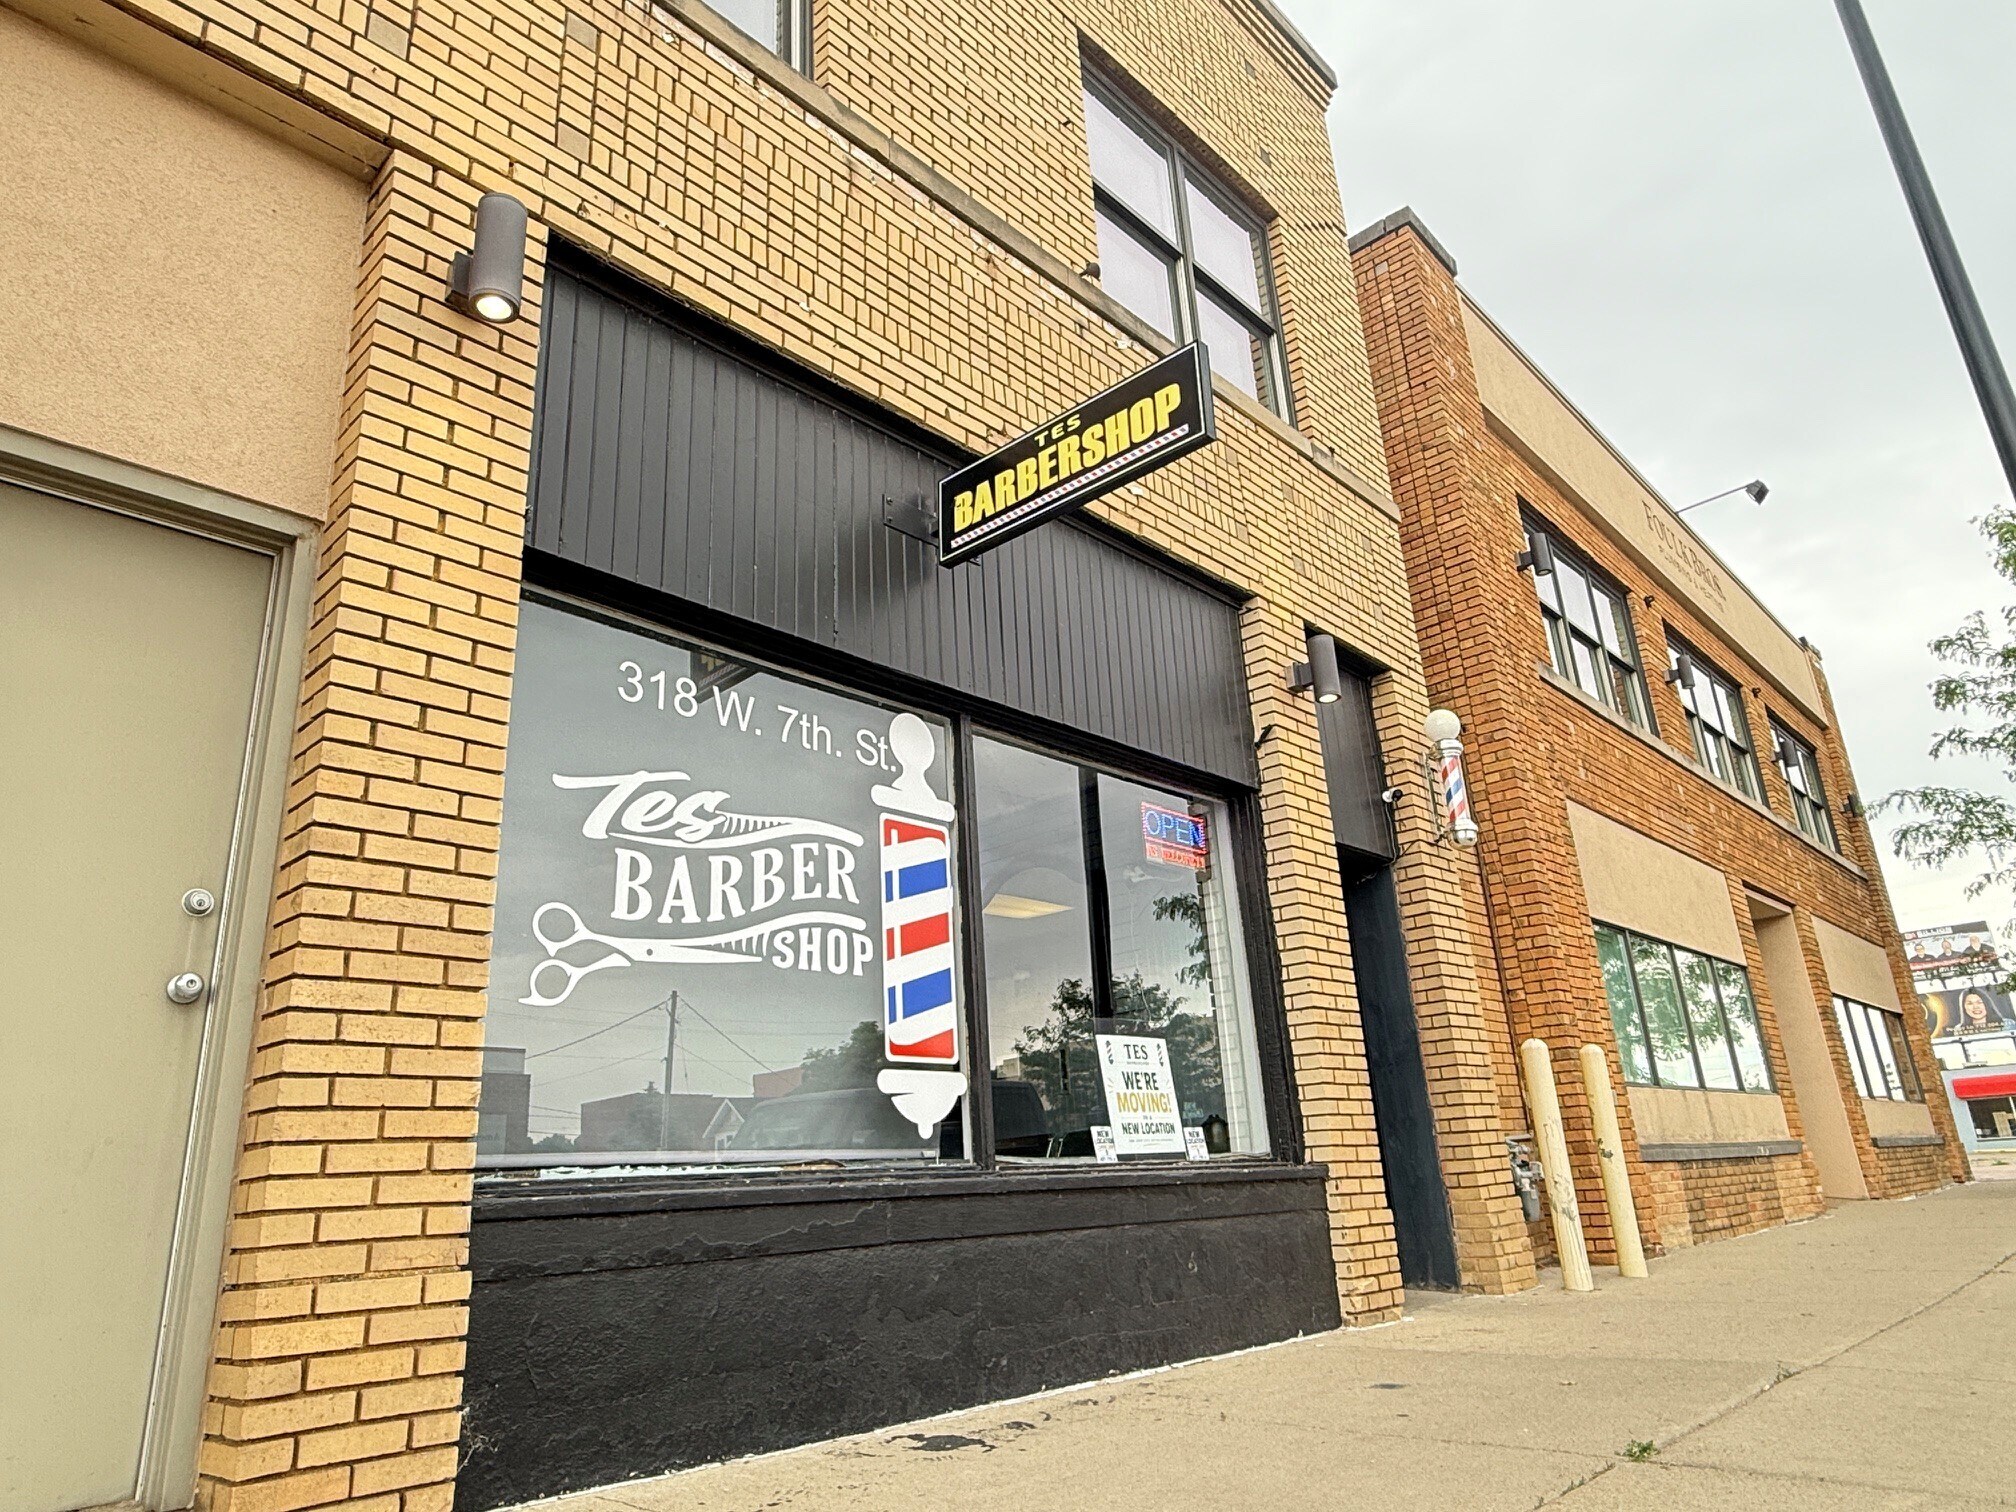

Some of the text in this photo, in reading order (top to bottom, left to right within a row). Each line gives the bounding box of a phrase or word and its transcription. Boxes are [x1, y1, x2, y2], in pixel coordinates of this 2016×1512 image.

[1034, 413, 1081, 447] TES
[953, 382, 1181, 534] BARBERSHOP
[616, 660, 898, 773] 318 W. 7th. St.
[551, 769, 731, 843] Tes
[1145, 810, 1205, 848] OPEN
[610, 842, 860, 925] BARBER
[772, 926, 874, 977] SHOP
[1123, 1044, 1149, 1060] TES
[1121, 1070, 1159, 1090] WE'RE
[1116, 1092, 1172, 1113] MOVING!
[1121, 1122, 1176, 1135] NEW LOCATION
